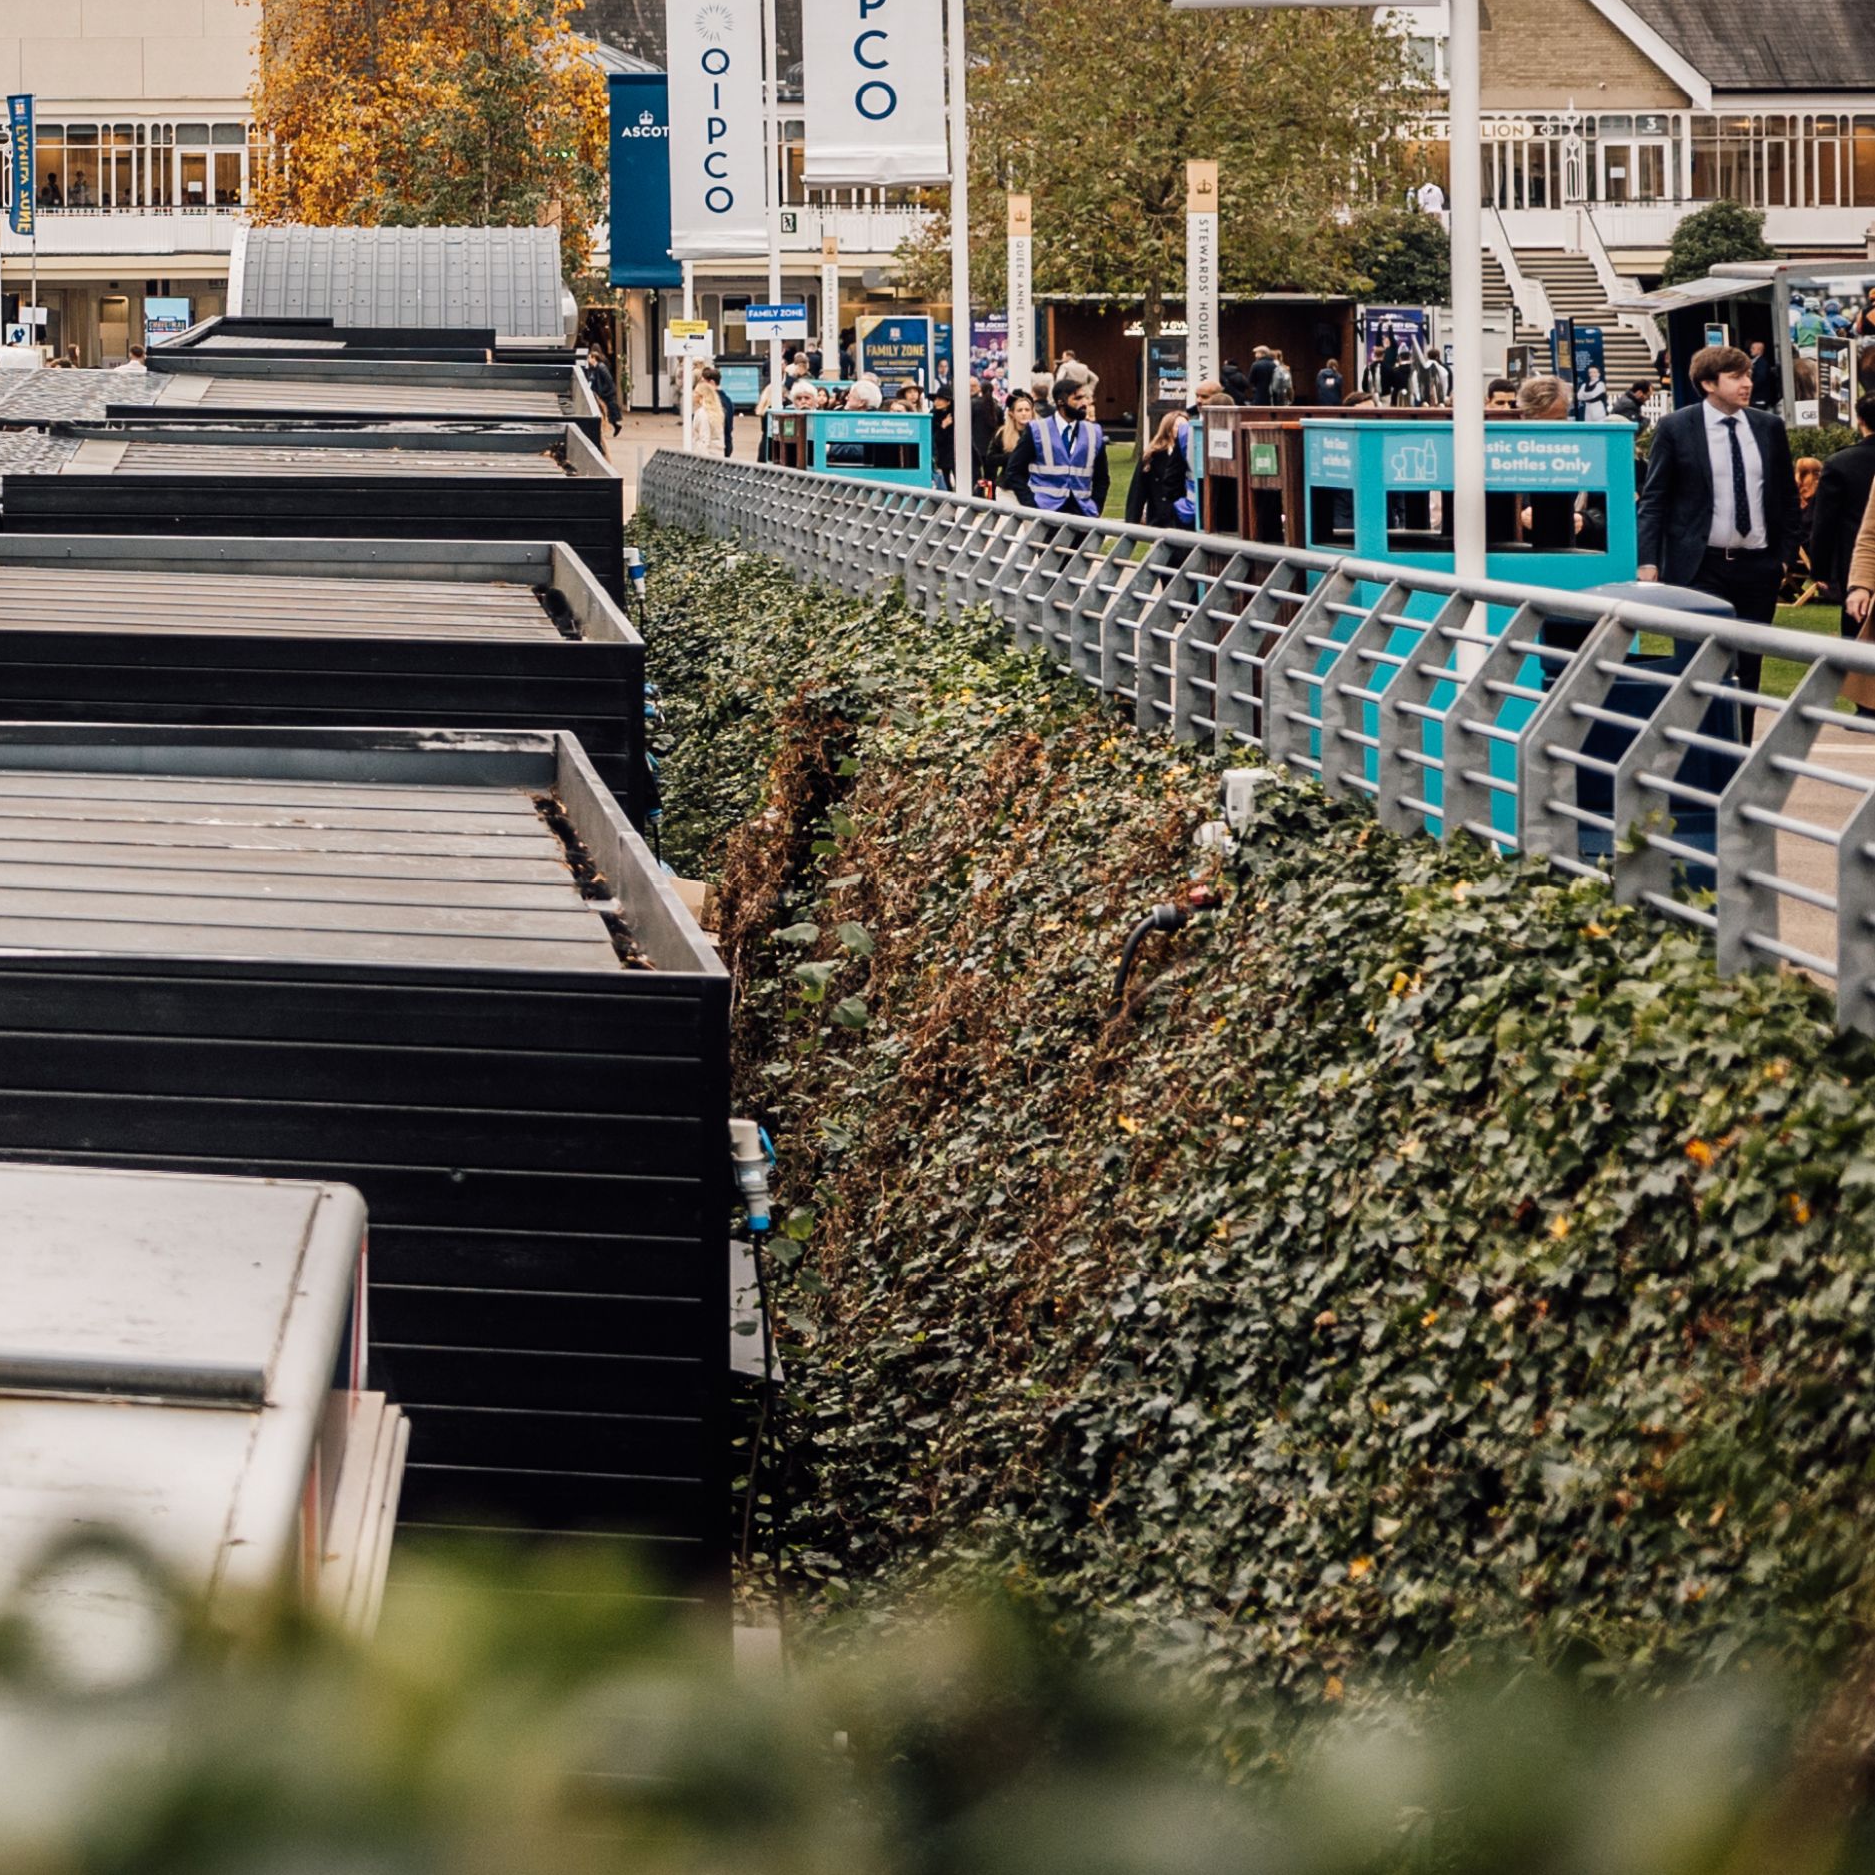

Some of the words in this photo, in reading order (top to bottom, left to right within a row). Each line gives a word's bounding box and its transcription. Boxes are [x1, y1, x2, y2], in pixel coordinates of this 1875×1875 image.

[621, 126, 669, 138] ASCOT
[701, 48, 734, 213] QIPCO
[1646, 117, 1657, 130] 3
[1016, 240, 1025, 278] QUEEN
[1198, 219, 1209, 296] STEWARDS'
[1016, 286, 1025, 312] ANNE
[748, 309, 779, 318] FAMILY
[780, 309, 804, 317] ZONE
[1198, 302, 1209, 349] HOUSE
[1016, 317, 1025, 348] LAWN
[866, 345, 899, 357] FAMILY
[901, 345, 925, 357] ZONE
[1199, 355, 1209, 381] LAW
[1484, 440, 1512, 453] stic
[1517, 440, 1580, 454] Glasses
[1491, 457, 1546, 471] Bottles
[1551, 458, 1591, 474] Only
